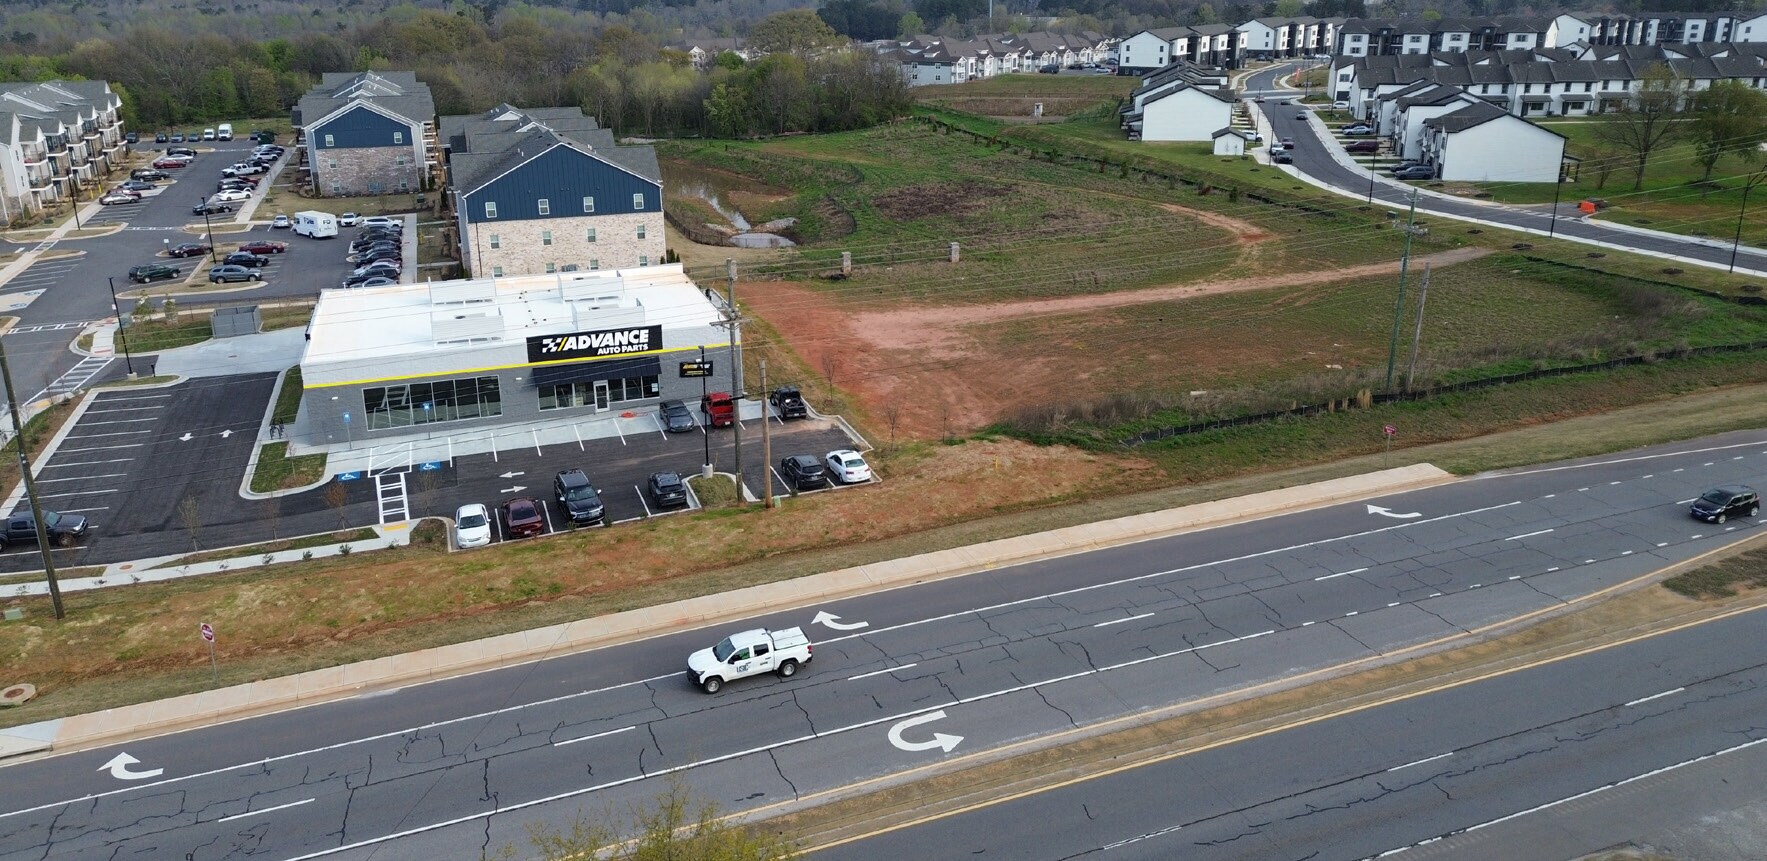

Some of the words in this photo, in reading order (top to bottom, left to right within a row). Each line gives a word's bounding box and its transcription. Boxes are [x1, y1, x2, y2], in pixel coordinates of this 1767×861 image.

[563, 329, 649, 351] ADVANCE
[597, 346, 620, 355] AUTO
[621, 343, 649, 353] PARTS
